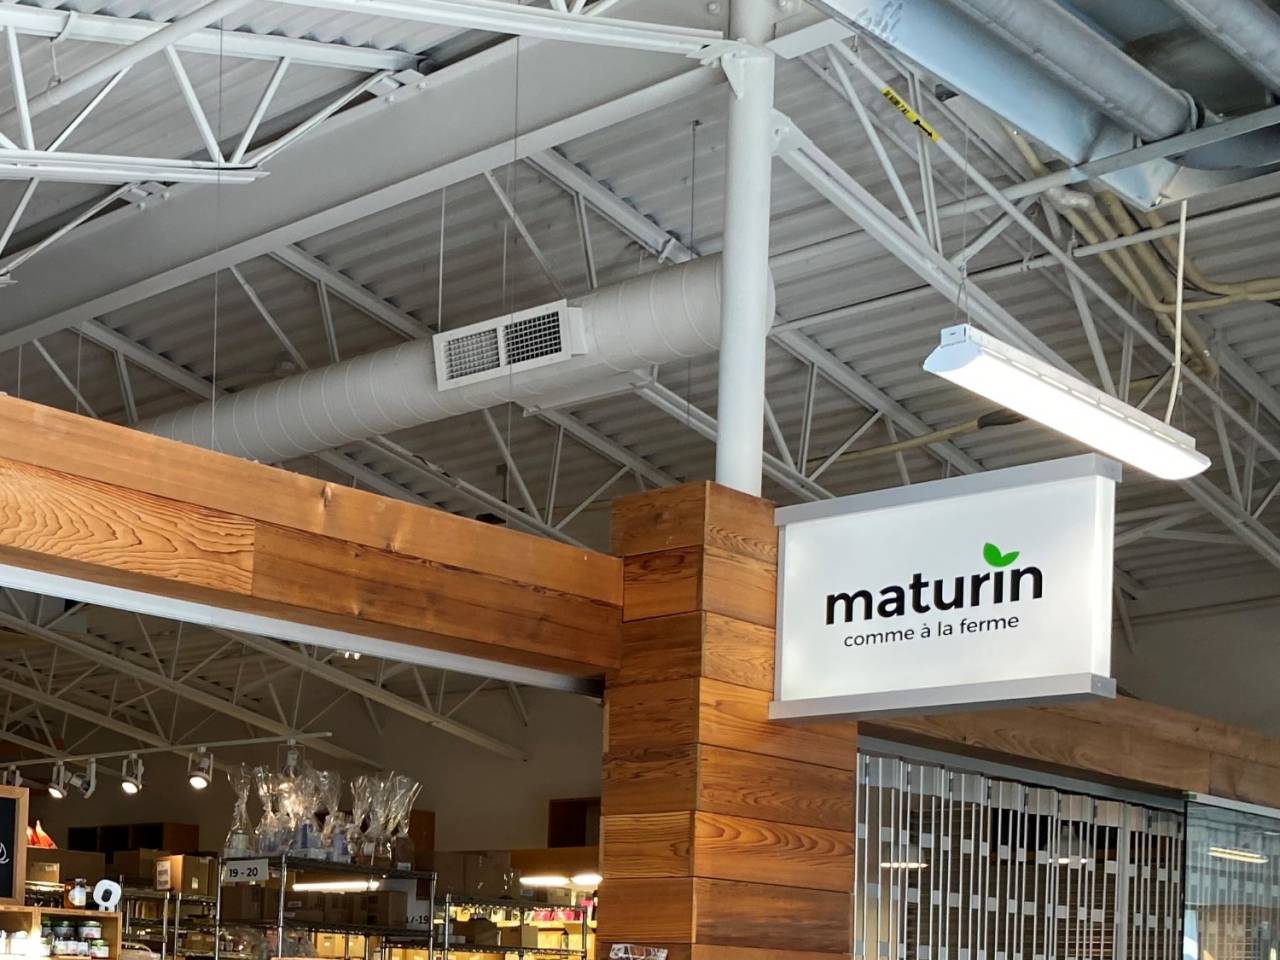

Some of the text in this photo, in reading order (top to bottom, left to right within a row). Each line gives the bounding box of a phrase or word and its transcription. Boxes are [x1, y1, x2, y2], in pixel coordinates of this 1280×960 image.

[825, 564, 1044, 625] maturin
[843, 612, 1020, 648] comme à la ferme
[228, 868, 239, 878] 19
[247, 867, 259, 878] 20
